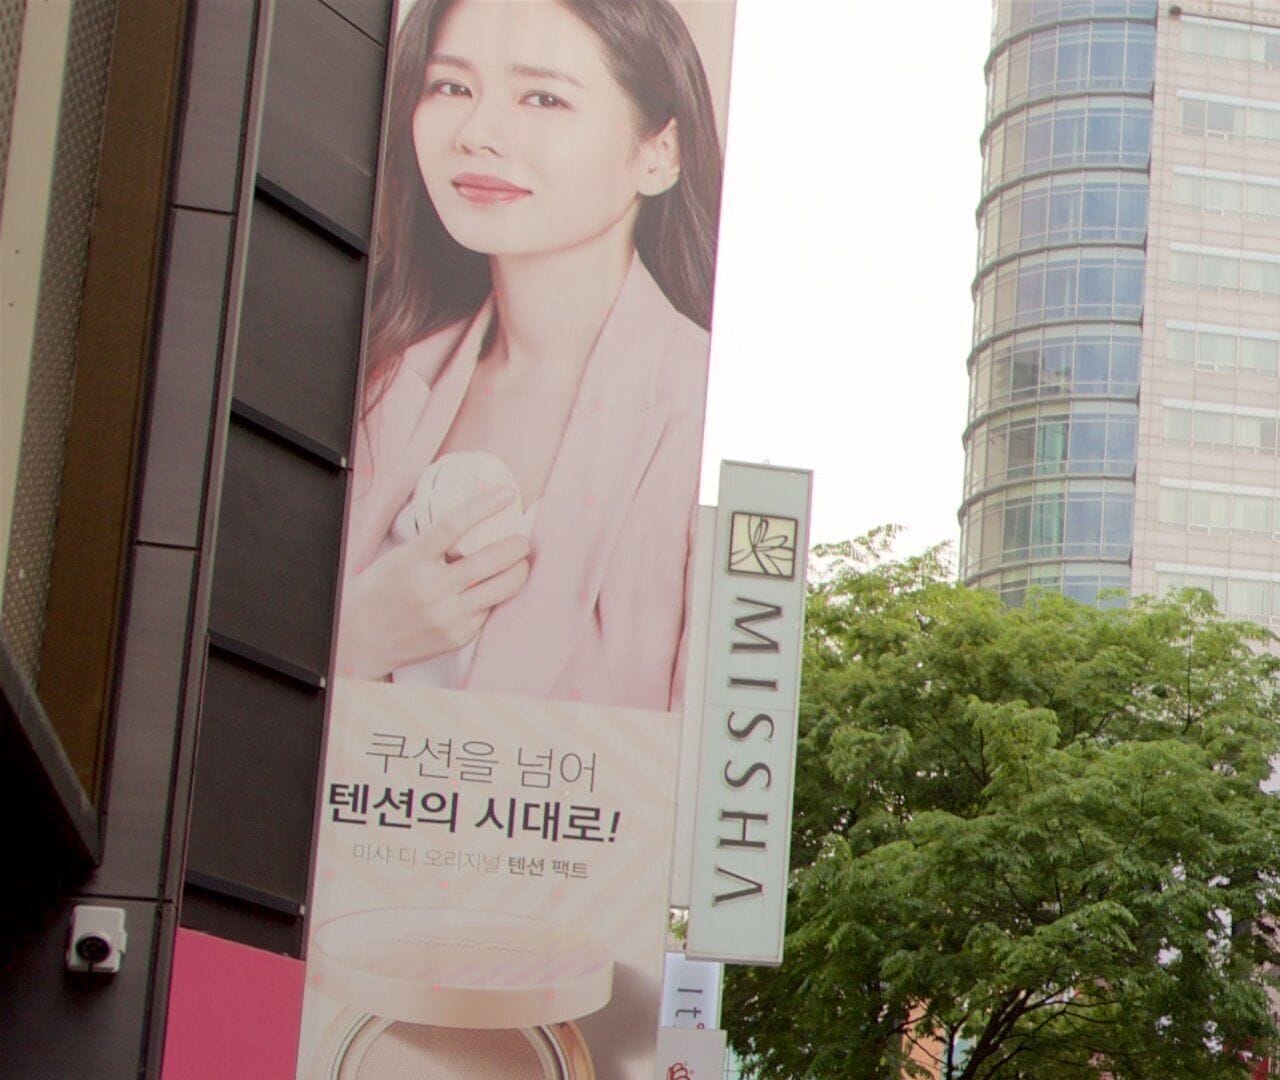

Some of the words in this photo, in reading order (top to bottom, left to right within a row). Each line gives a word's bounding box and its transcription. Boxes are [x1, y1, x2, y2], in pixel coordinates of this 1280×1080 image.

[366, 733, 499, 784] 쿠션을
[517, 745, 599, 793] 넘어
[713, 596, 784, 907] MISSHA
[329, 783, 459, 833] 텐션의
[475, 798, 621, 844] 시대로!
[422, 848, 501, 873] 오리지널
[508, 856, 545, 878] 텐션
[552, 859, 589, 879] 팩트
